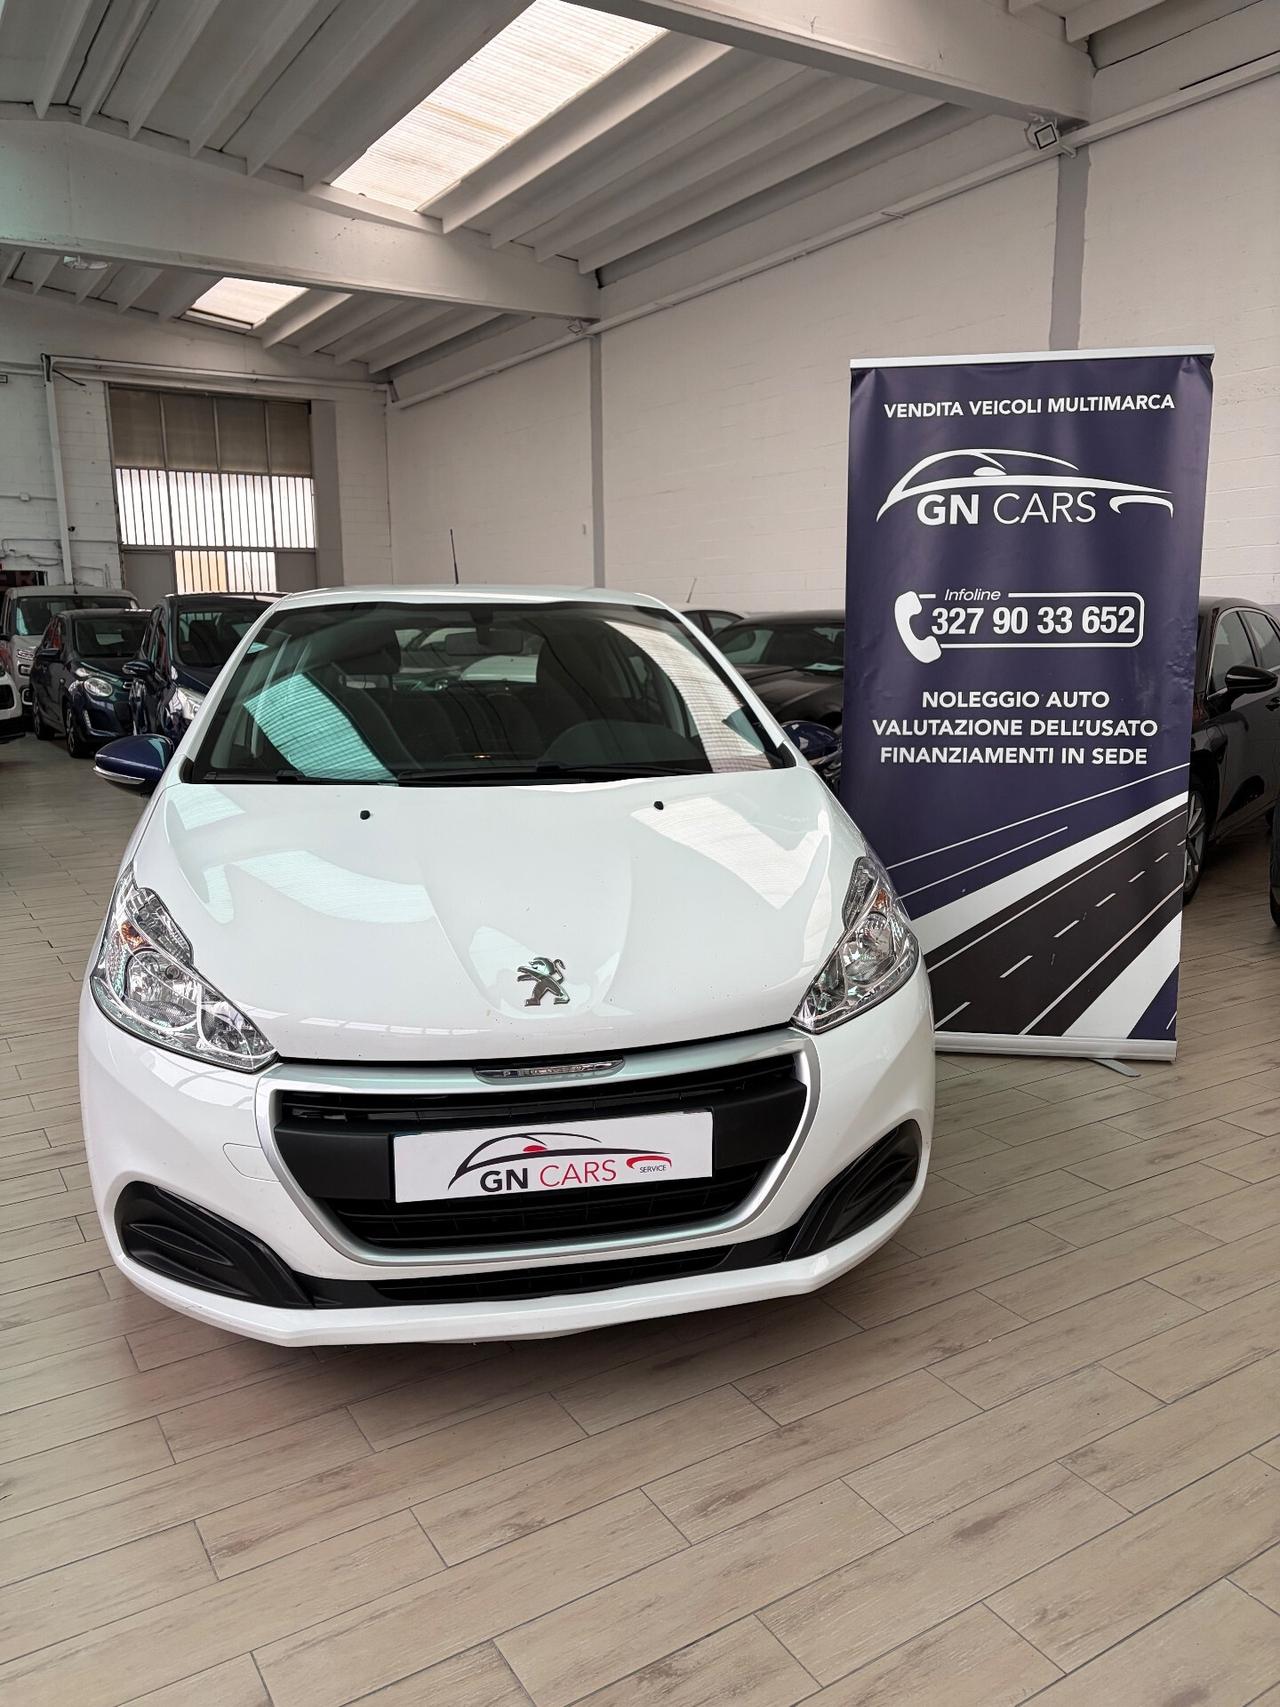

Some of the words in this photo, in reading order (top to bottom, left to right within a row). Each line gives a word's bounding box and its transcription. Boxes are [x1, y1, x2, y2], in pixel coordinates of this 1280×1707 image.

[884, 401, 964, 418] VENDITA
[969, 398, 1042, 416] VEICOLI
[1047, 394, 1175, 413] MULTIMARCA
[916, 494, 979, 525] GN
[993, 492, 1096, 524] CARS
[945, 588, 1001, 601] Infoline
[931, 607, 984, 635] 327
[993, 606, 1028, 634] 90
[1037, 606, 1073, 634] 33
[1082, 606, 1135, 633] 652
[922, 691, 1040, 708] NOLEGGIO
[1046, 691, 1110, 708] AUTO
[873, 719, 1022, 736] VALUTAZIONE
[1030, 719, 1158, 737] DELL'USATO
[880, 747, 1054, 764] FINANZIAMENTI
[1061, 747, 1085, 764] IN
[1092, 747, 1148, 765] SEDE
[480, 1168, 528, 1193] GN
[539, 1159, 617, 1189] CARS
[639, 1164, 667, 1174] SERVICE
